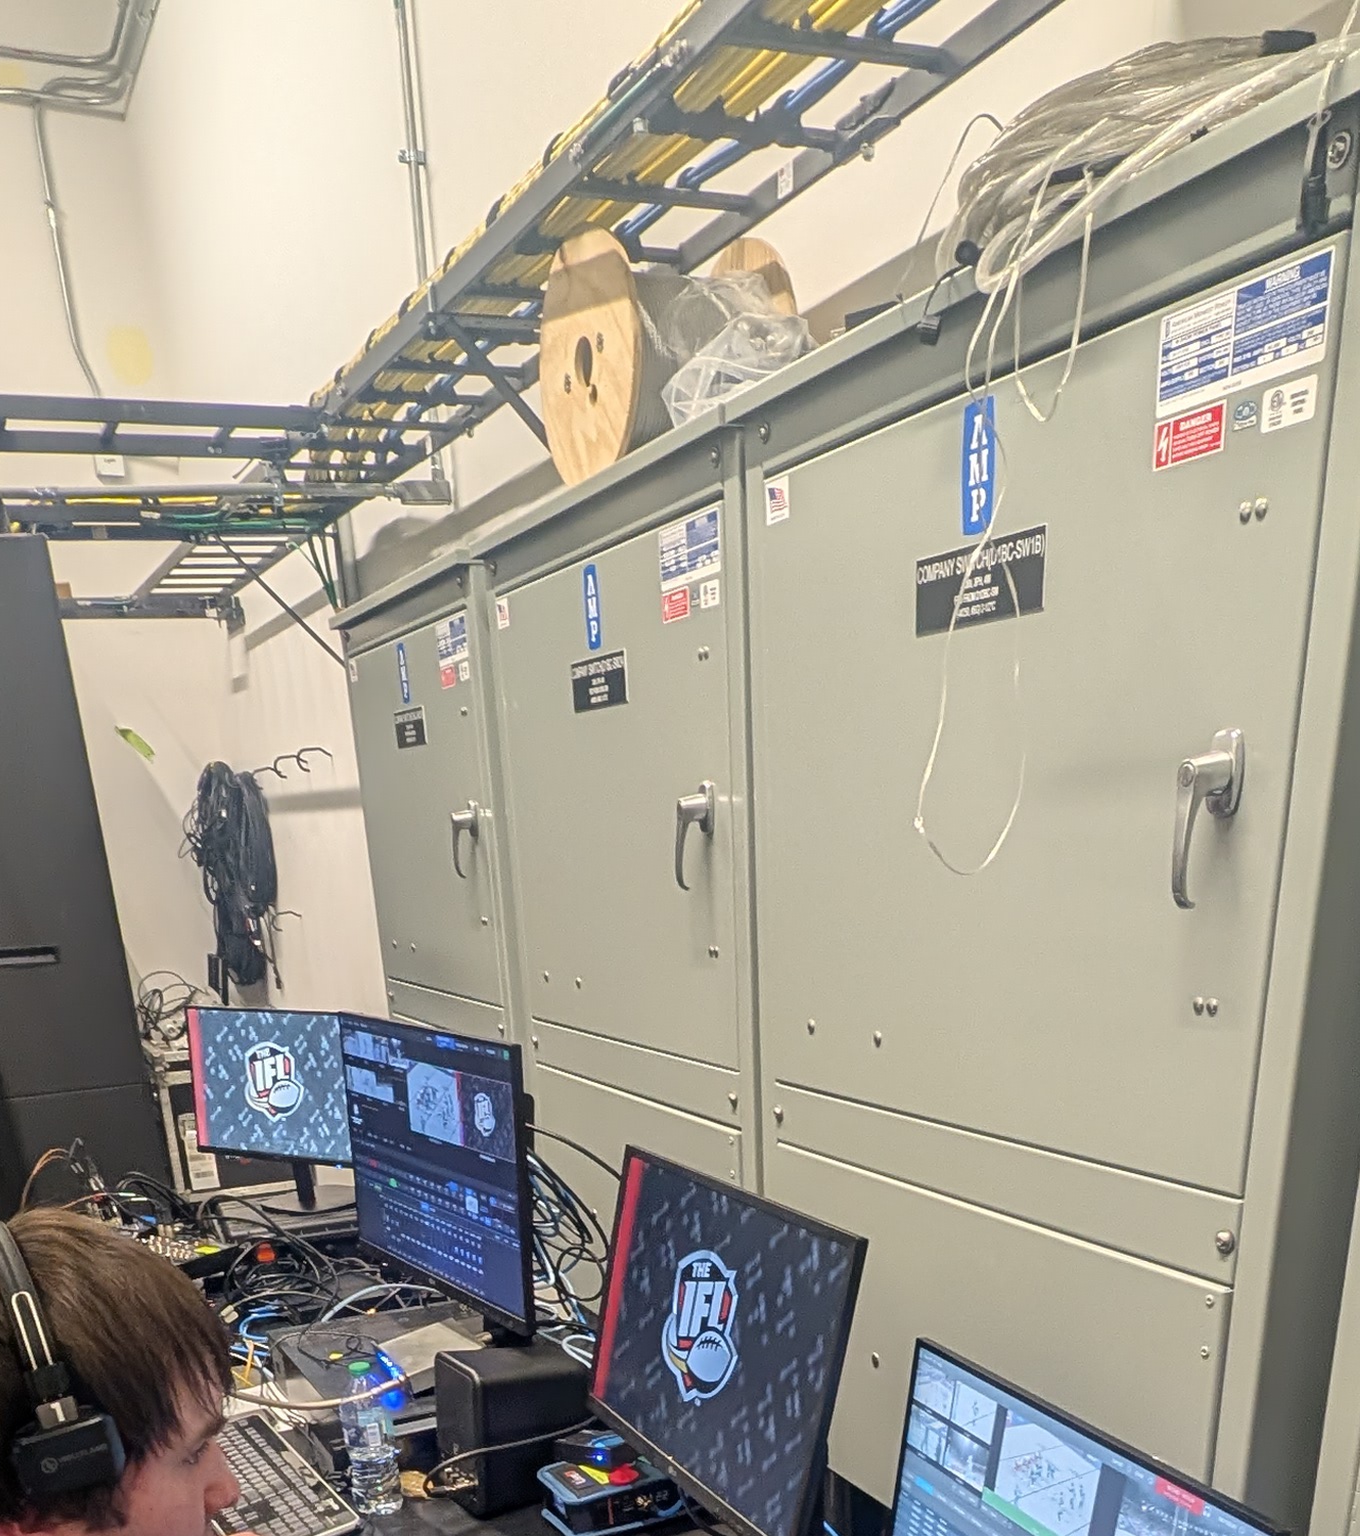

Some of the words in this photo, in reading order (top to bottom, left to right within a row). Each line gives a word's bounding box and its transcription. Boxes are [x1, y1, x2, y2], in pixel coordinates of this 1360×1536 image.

[1179, 412, 1213, 431] DANGER
[968, 413, 990, 524] AMP
[917, 557, 957, 586] COMPANY
[586, 573, 599, 644] AMP
[252, 1053, 290, 1092] IFL
[692, 1261, 712, 1278] THE
[678, 1281, 727, 1338] IFL
[49, 1401, 66, 1422] 1
